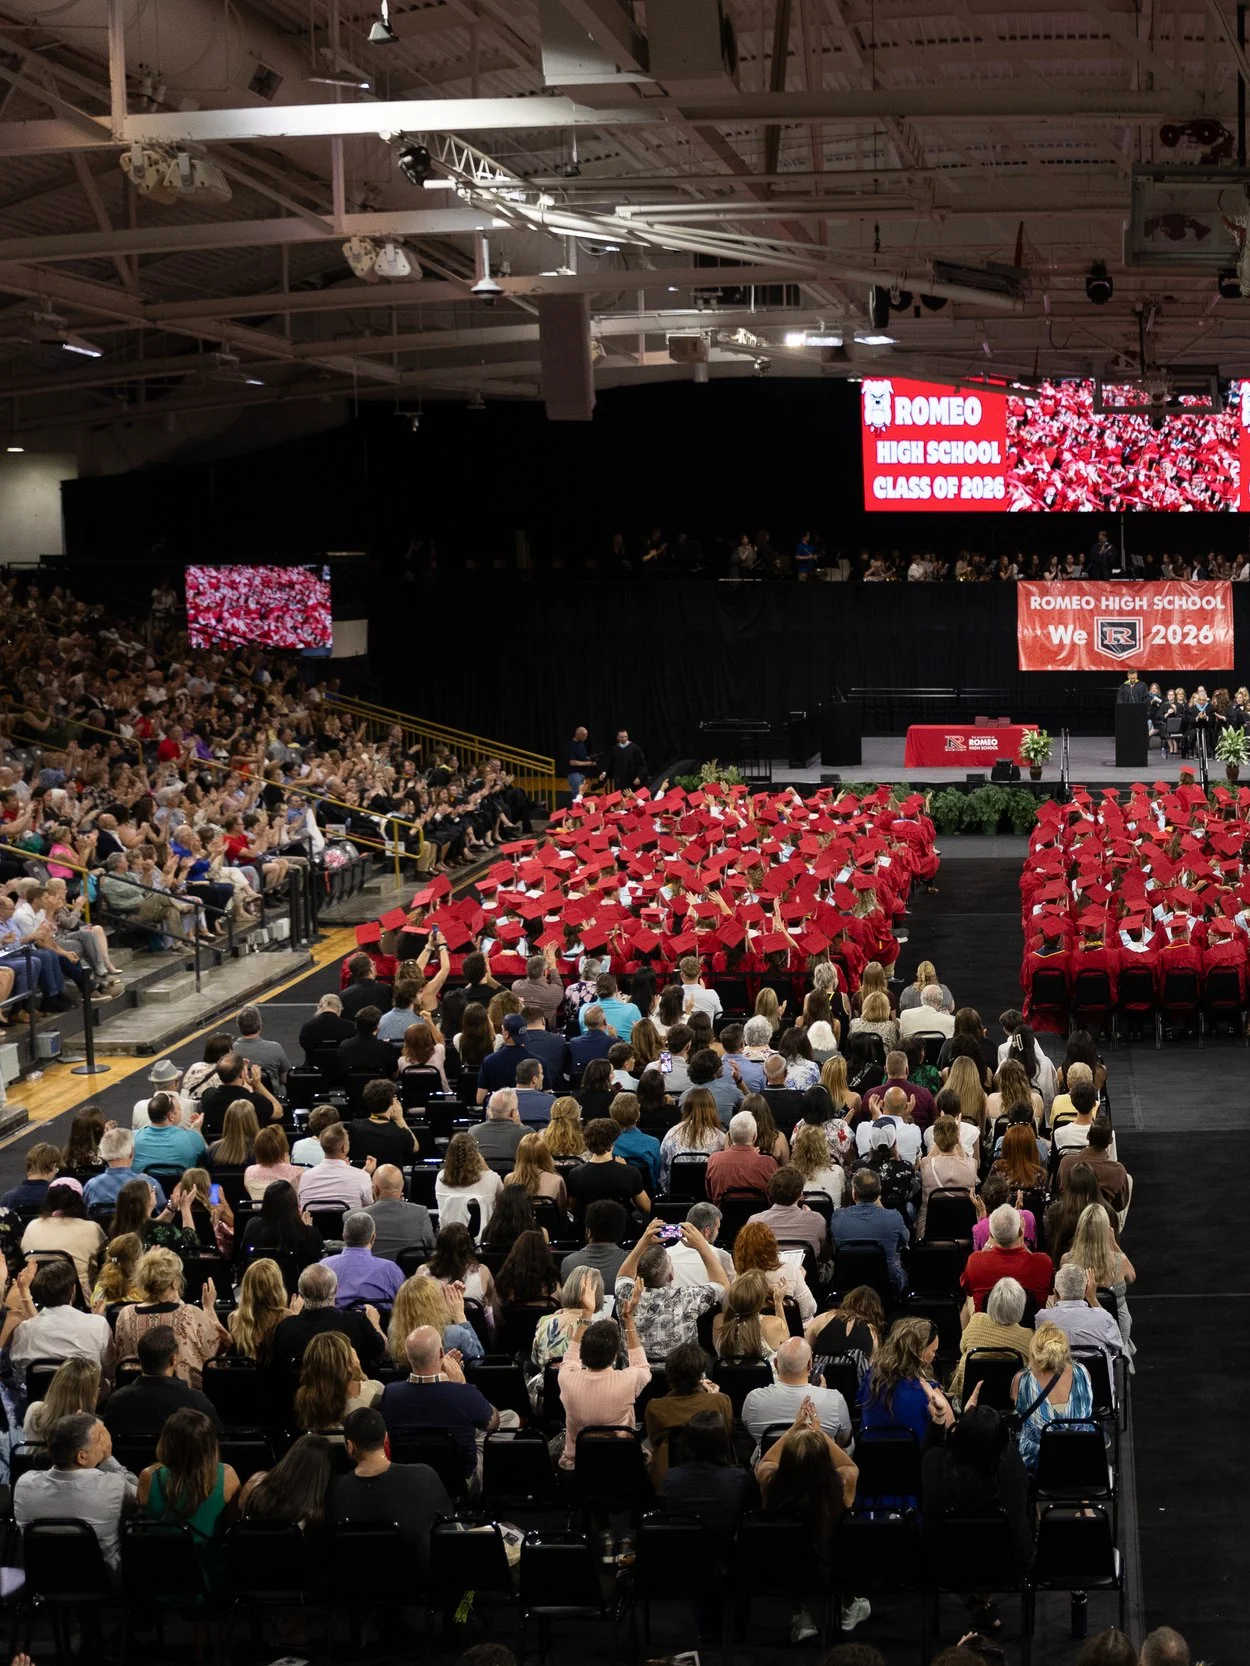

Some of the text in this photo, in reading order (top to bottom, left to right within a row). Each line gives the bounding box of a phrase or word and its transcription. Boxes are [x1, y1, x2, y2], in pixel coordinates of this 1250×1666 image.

[894, 395, 982, 426] ROMEO
[876, 440, 1002, 464] HIGH SCHOOL
[872, 475, 1006, 500] CLASS OF 2026
[1030, 595, 1226, 610] ROMEO HIGH SCHOOL
[1049, 624, 1214, 646] We R 2026
